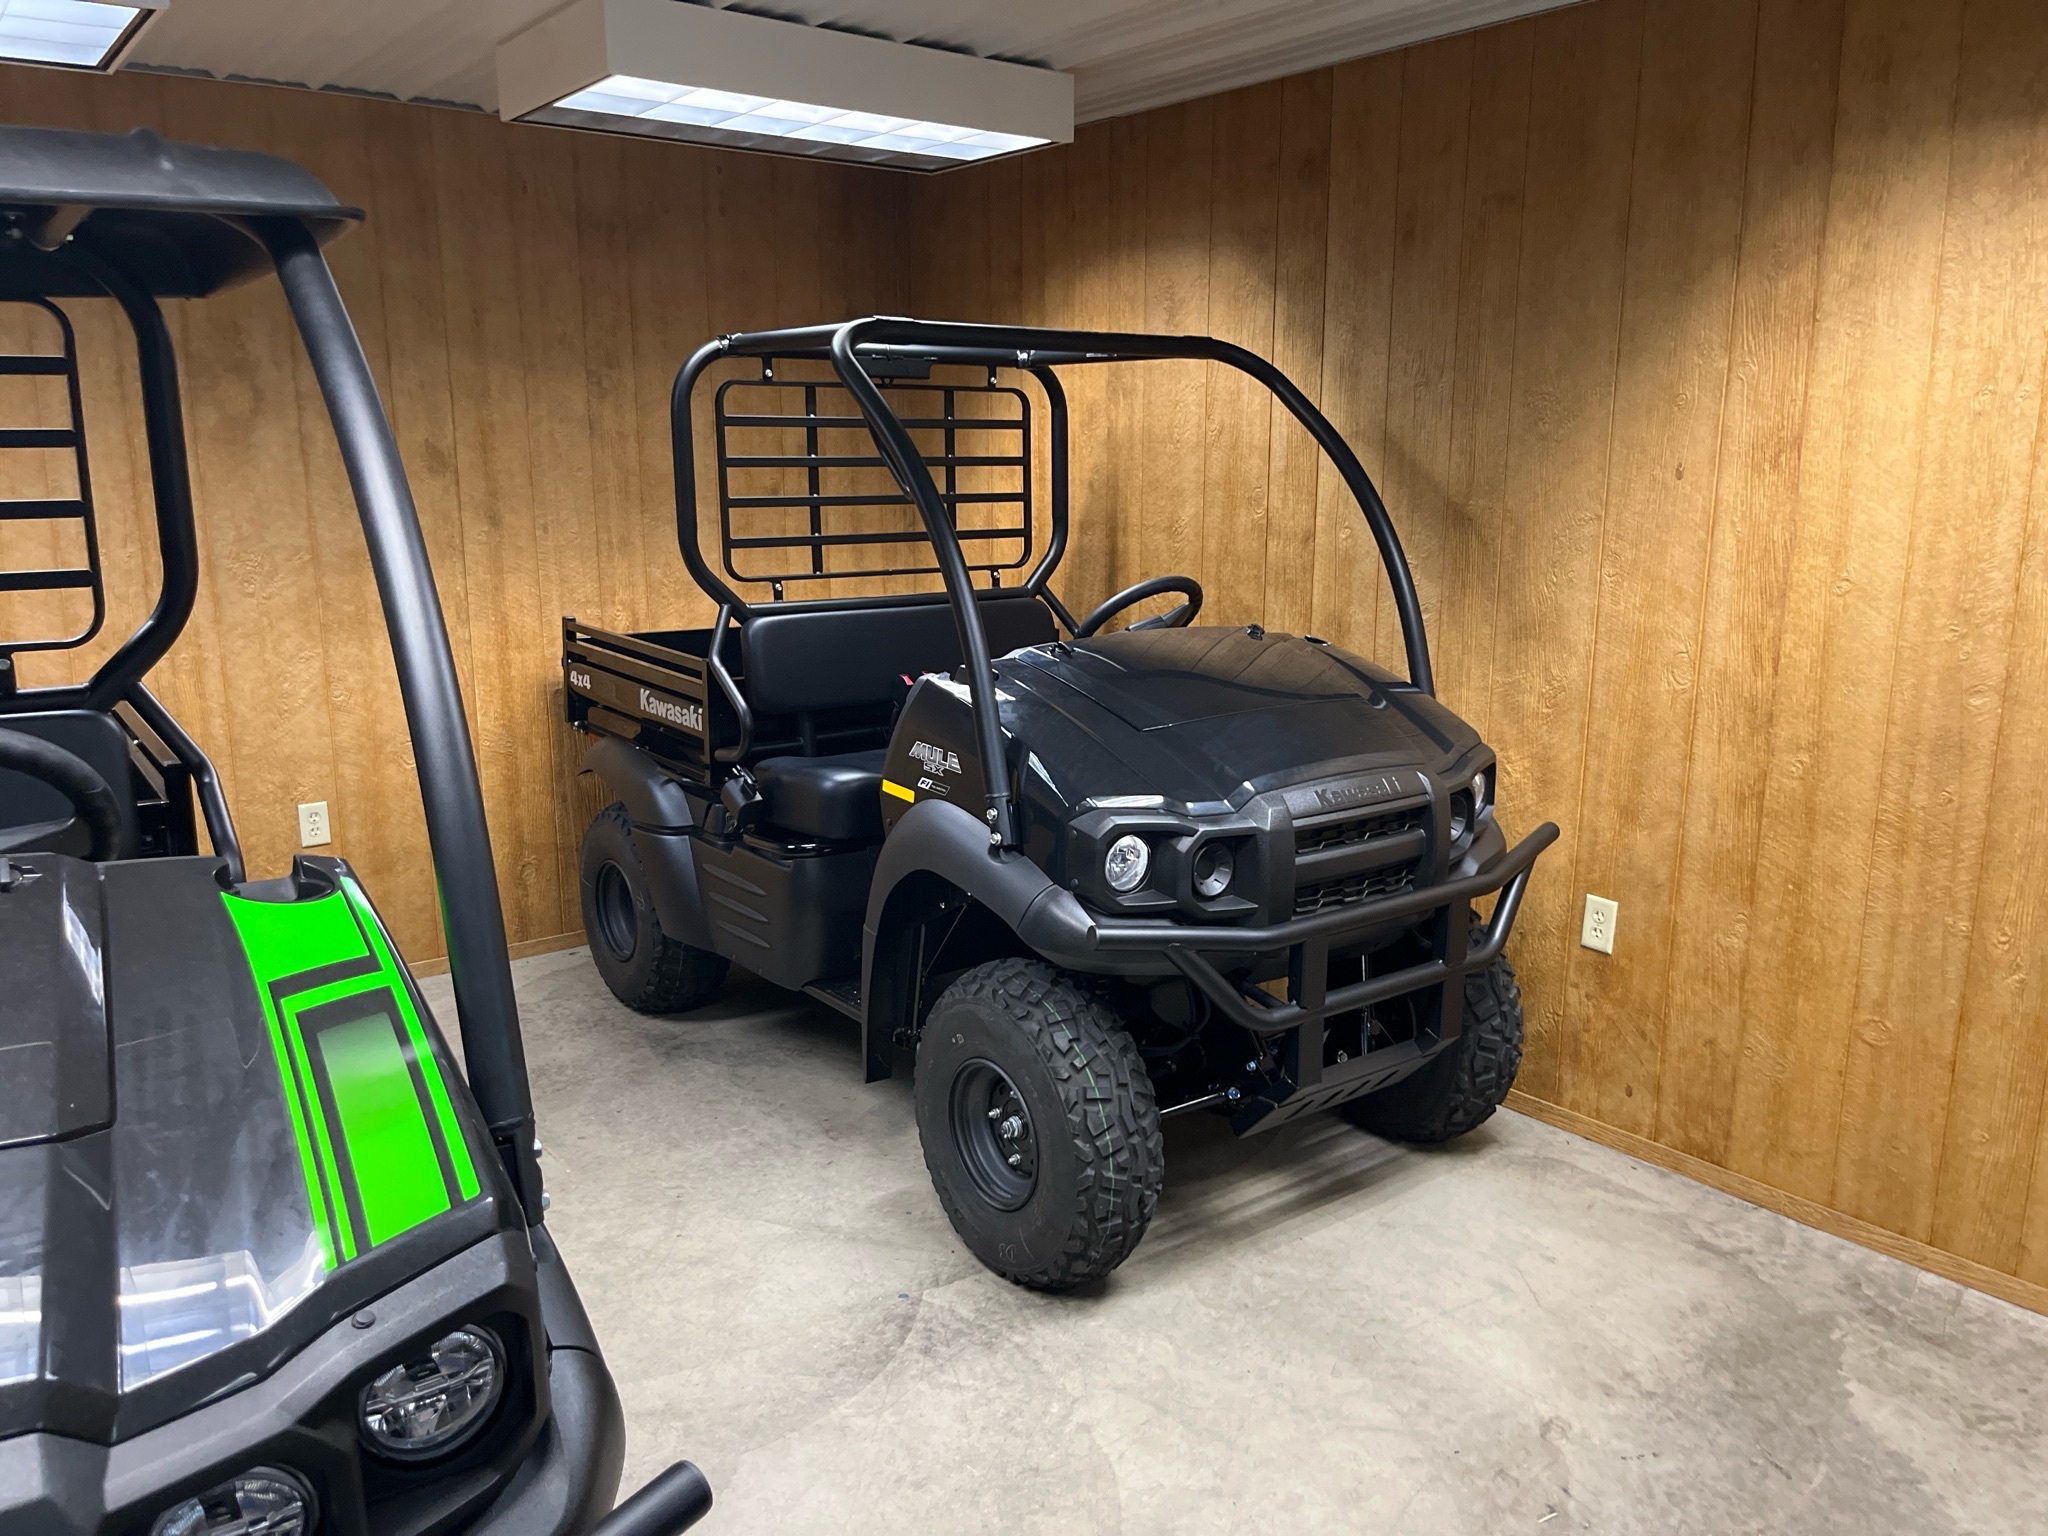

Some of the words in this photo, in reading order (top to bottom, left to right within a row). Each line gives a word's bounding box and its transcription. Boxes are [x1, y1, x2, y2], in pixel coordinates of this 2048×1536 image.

[570, 670, 592, 690] 4x4
[639, 687, 703, 732] Kawasaki
[909, 740, 962, 774] MULE
[923, 761, 945, 777] SX
[1313, 776, 1404, 808] Kawasaki
